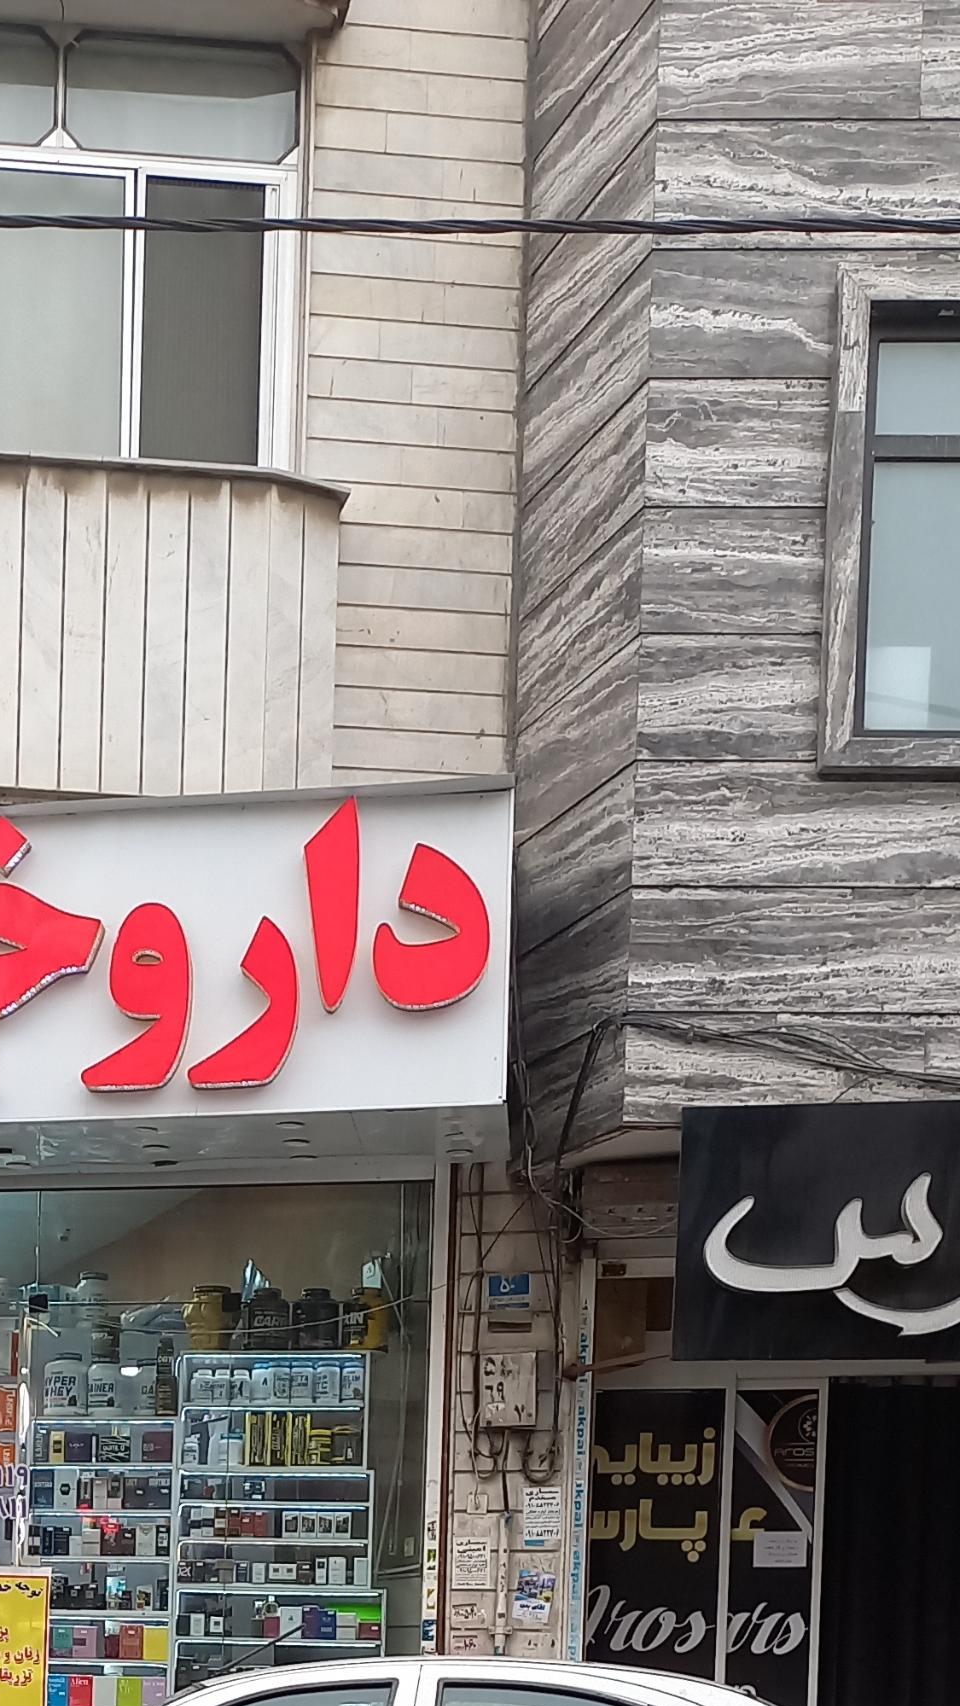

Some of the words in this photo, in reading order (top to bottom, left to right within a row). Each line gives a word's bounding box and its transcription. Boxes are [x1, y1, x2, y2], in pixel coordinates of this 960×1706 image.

[16, 1581, 44, 1599] توجه
[4, 1652, 11, 1663] و
[13, 1646, 41, 1664] زنان
